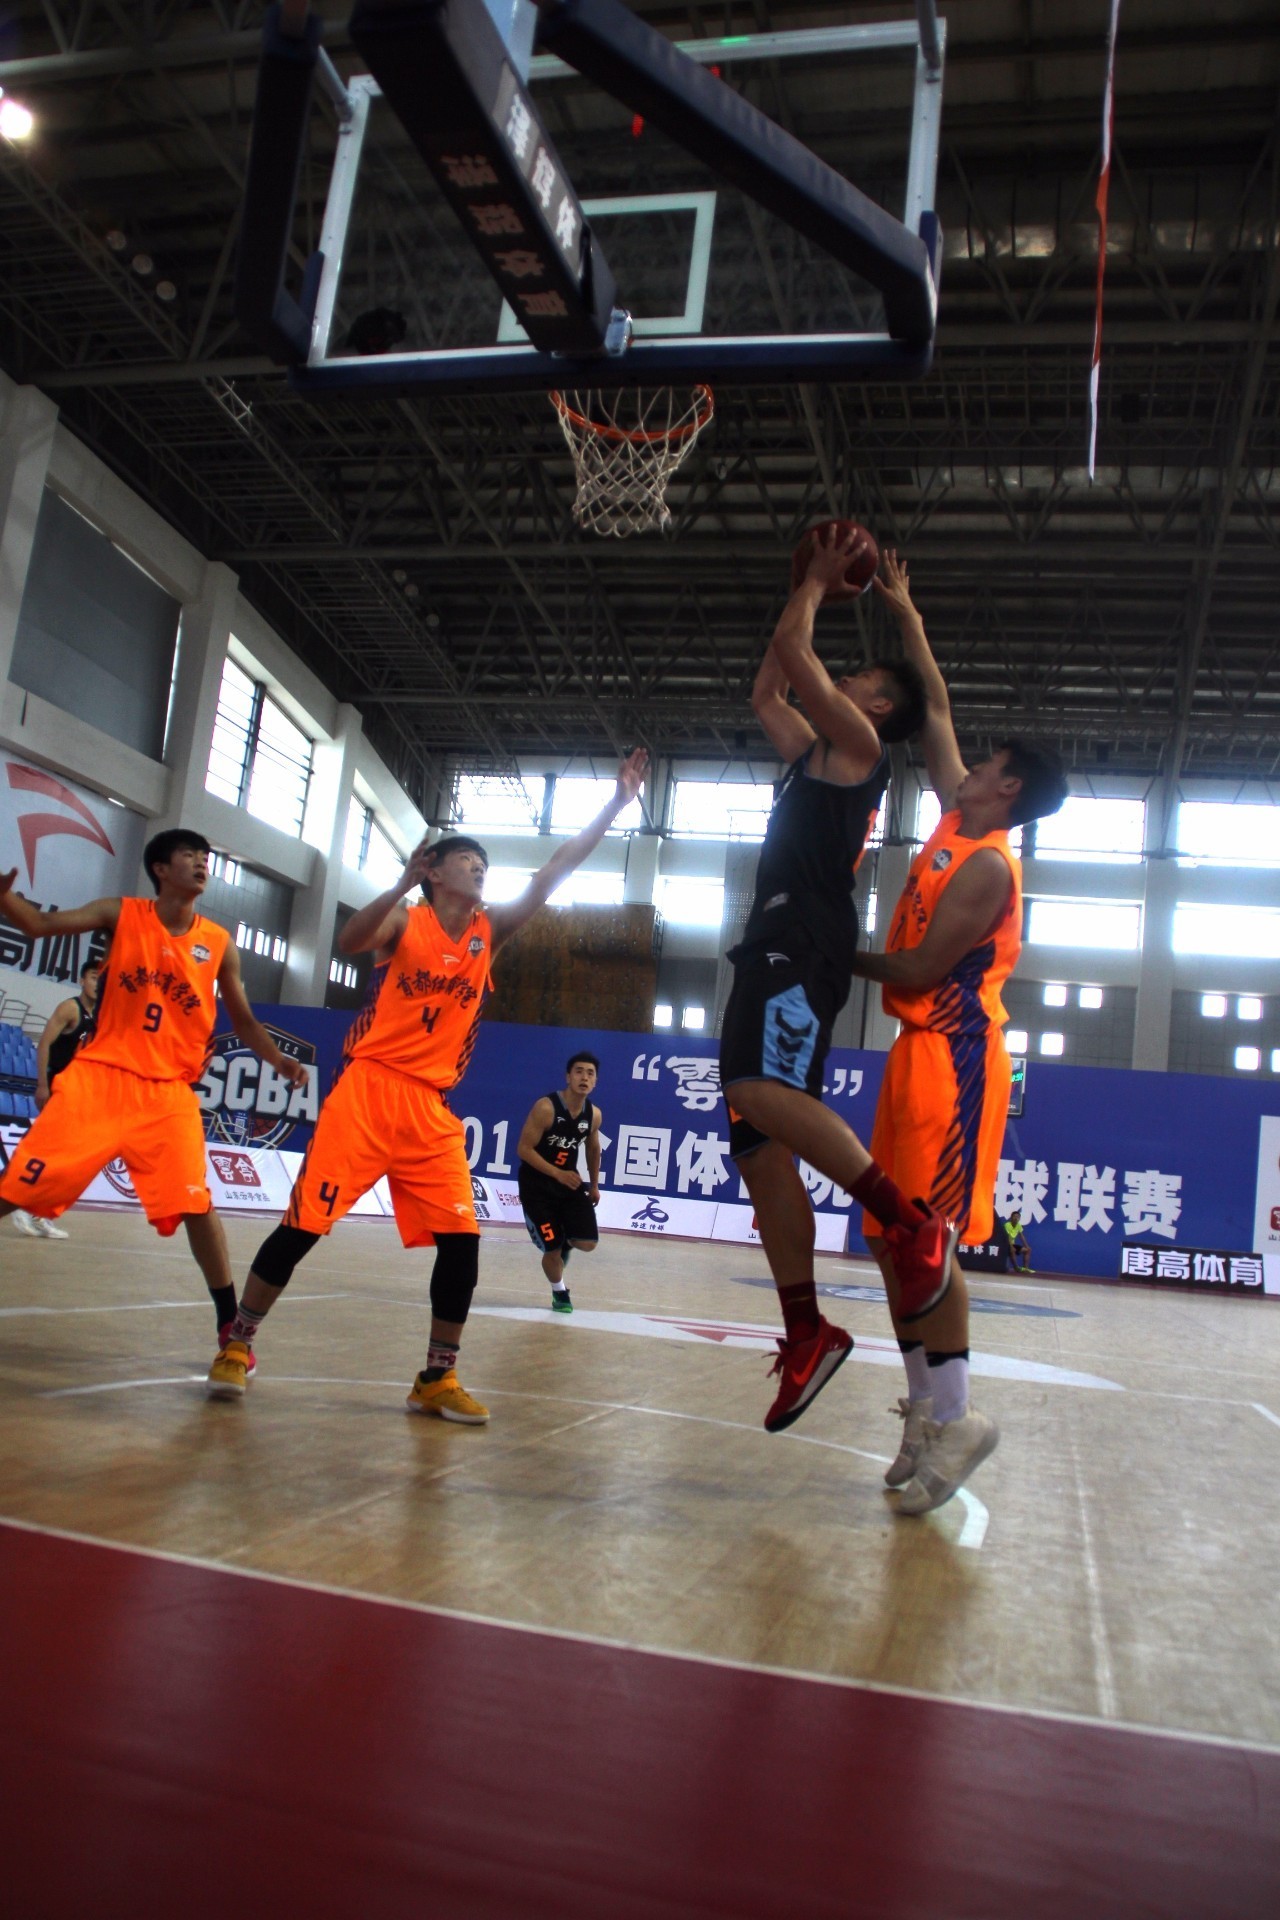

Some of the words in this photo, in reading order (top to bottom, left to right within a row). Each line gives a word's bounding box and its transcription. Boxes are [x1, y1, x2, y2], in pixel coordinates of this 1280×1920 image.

[142, 1002, 163, 1033] 9
[421, 1006, 441, 1034] 4
[194, 1054, 319, 1123] SCBA
[19, 1158, 46, 1185] 9
[555, 1151, 569, 1166] 5
[319, 1181, 340, 1217] 4
[540, 1222, 555, 1242] 5
[1121, 1247, 1263, 1286] 唐高体育
